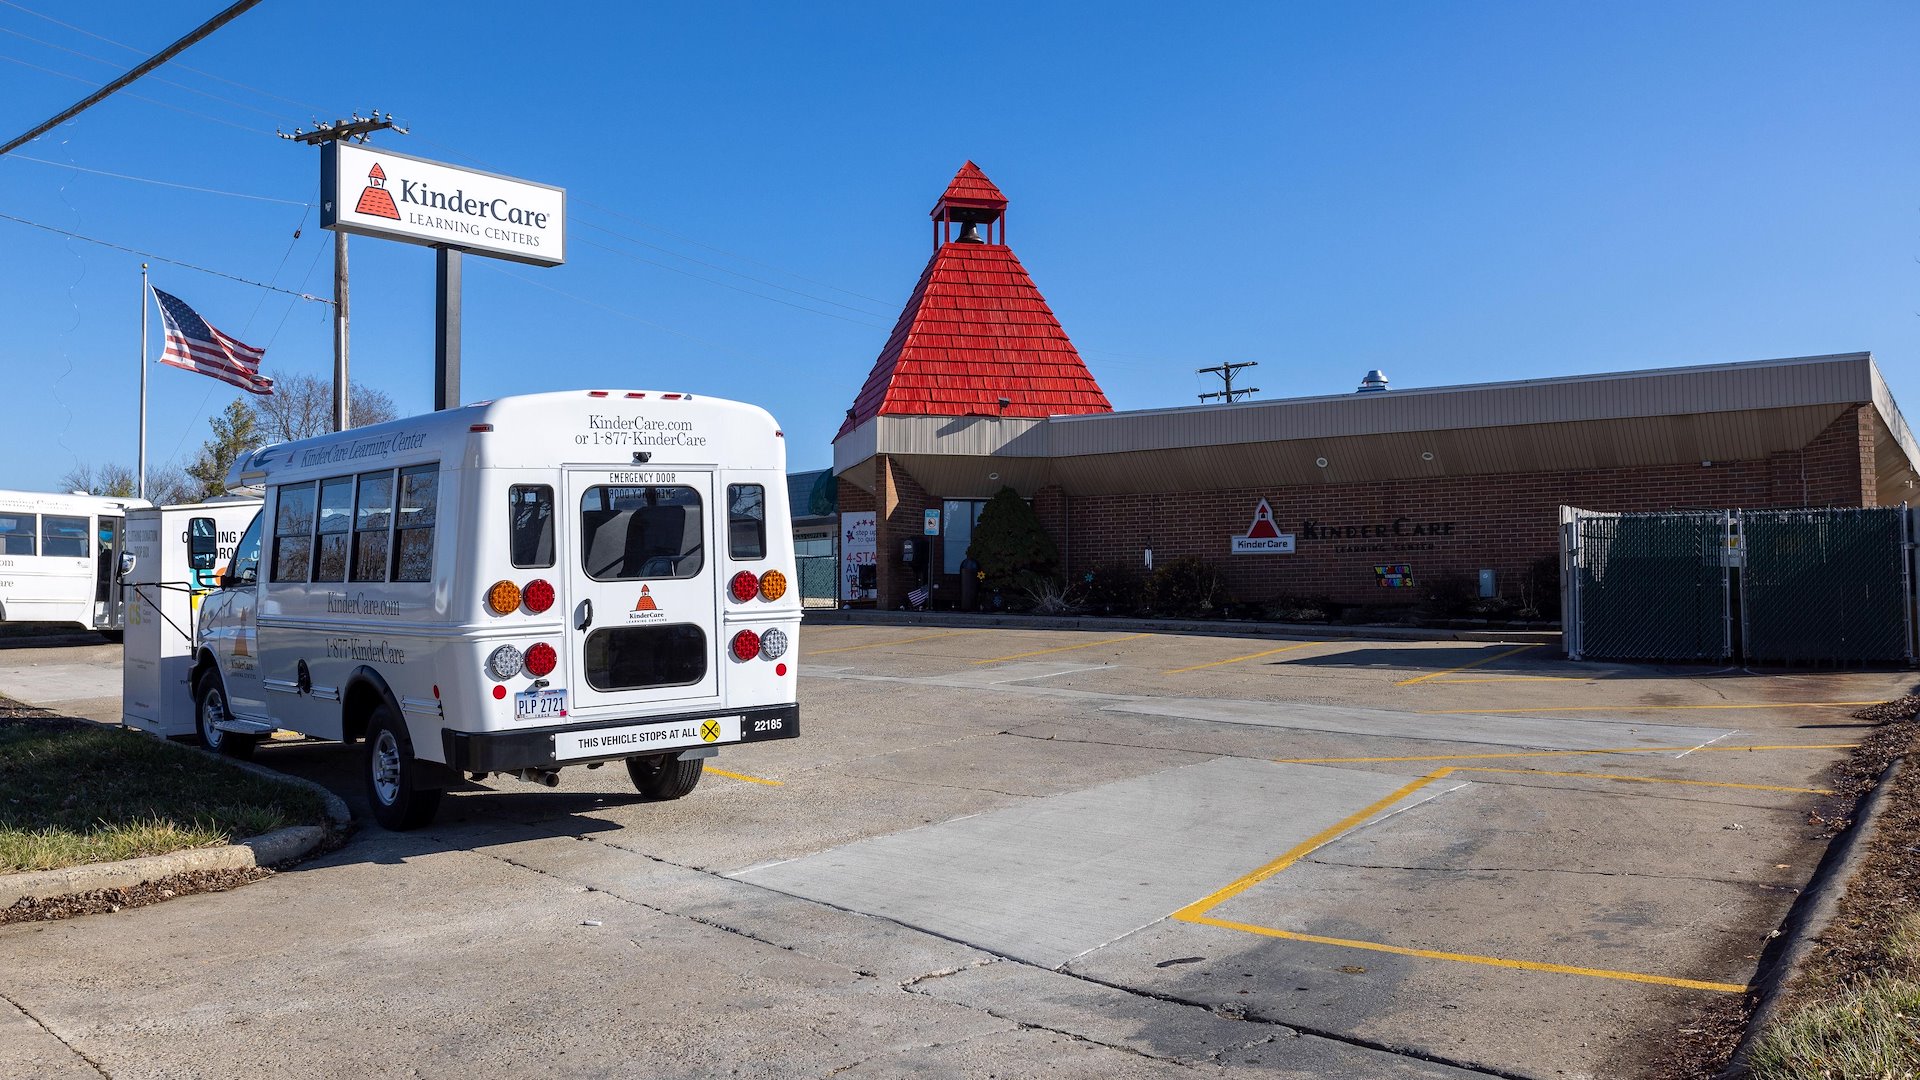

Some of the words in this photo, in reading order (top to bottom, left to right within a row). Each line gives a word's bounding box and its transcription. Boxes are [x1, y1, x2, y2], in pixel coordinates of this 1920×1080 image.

[400, 179, 548, 229] KinderCare
[409, 212, 480, 236] LEARNING
[484, 227, 540, 247] CENTERS
[588, 414, 692, 431] KinderCare.com
[574, 434, 589, 444] or
[593, 431, 706, 446] 1-877-KinderCare
[300, 444, 350, 468] KinderCare
[349, 435, 391, 459] Learning
[391, 431, 427, 452] Center
[609, 472, 653, 483] EMERGENCY
[656, 472, 676, 482] DOOR
[1237, 540, 1267, 549] Kinder
[1267, 539, 1288, 548] Care
[327, 591, 400, 616] KinderCare.com
[518, 699, 537, 715] PLP
[540, 696, 565, 713] 2721
[754, 718, 783, 732] 22185
[578, 738, 599, 749] THIS
[600, 734, 637, 747] VEHICLE
[639, 731, 667, 744] STOPS
[669, 729, 680, 740] AT
[681, 728, 698, 739] ALL
